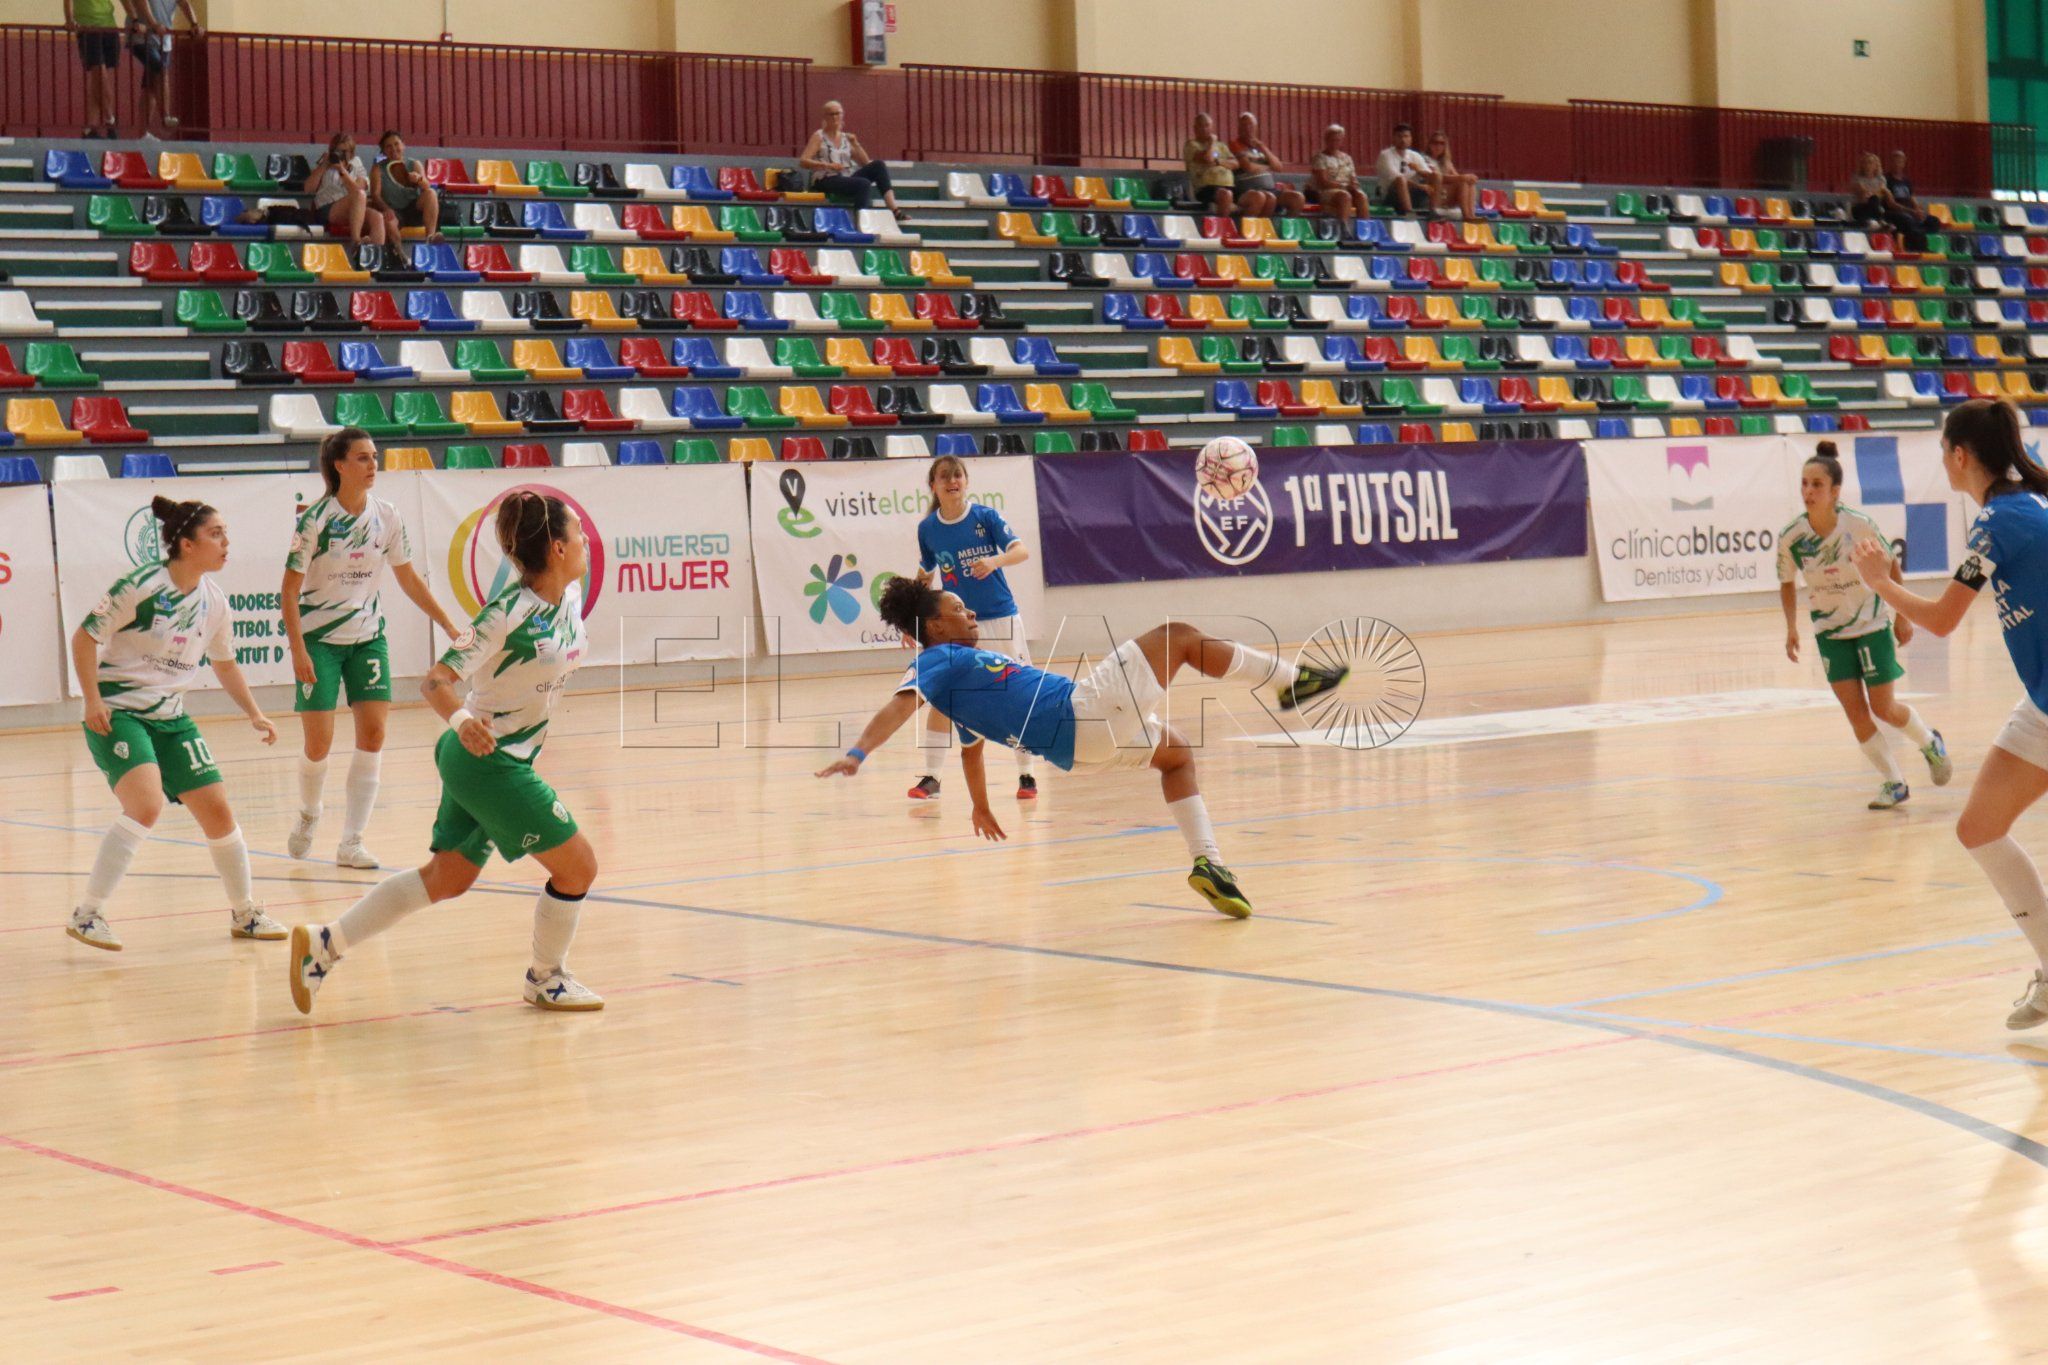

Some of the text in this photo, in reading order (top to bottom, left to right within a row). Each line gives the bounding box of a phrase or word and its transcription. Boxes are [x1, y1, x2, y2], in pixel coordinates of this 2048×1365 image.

[1328, 471, 1459, 545] FUTSAL
[1221, 515, 1249, 531] EF
[615, 534, 730, 558] UNIVERSO
[957, 544, 994, 560] MELILLA
[1611, 525, 1773, 560] clínicablasco
[617, 560, 730, 593] MUJER
[1634, 562, 1757, 586] Dentistas y Salud
[367, 658, 381, 684] 3
[182, 738, 216, 771] 10
